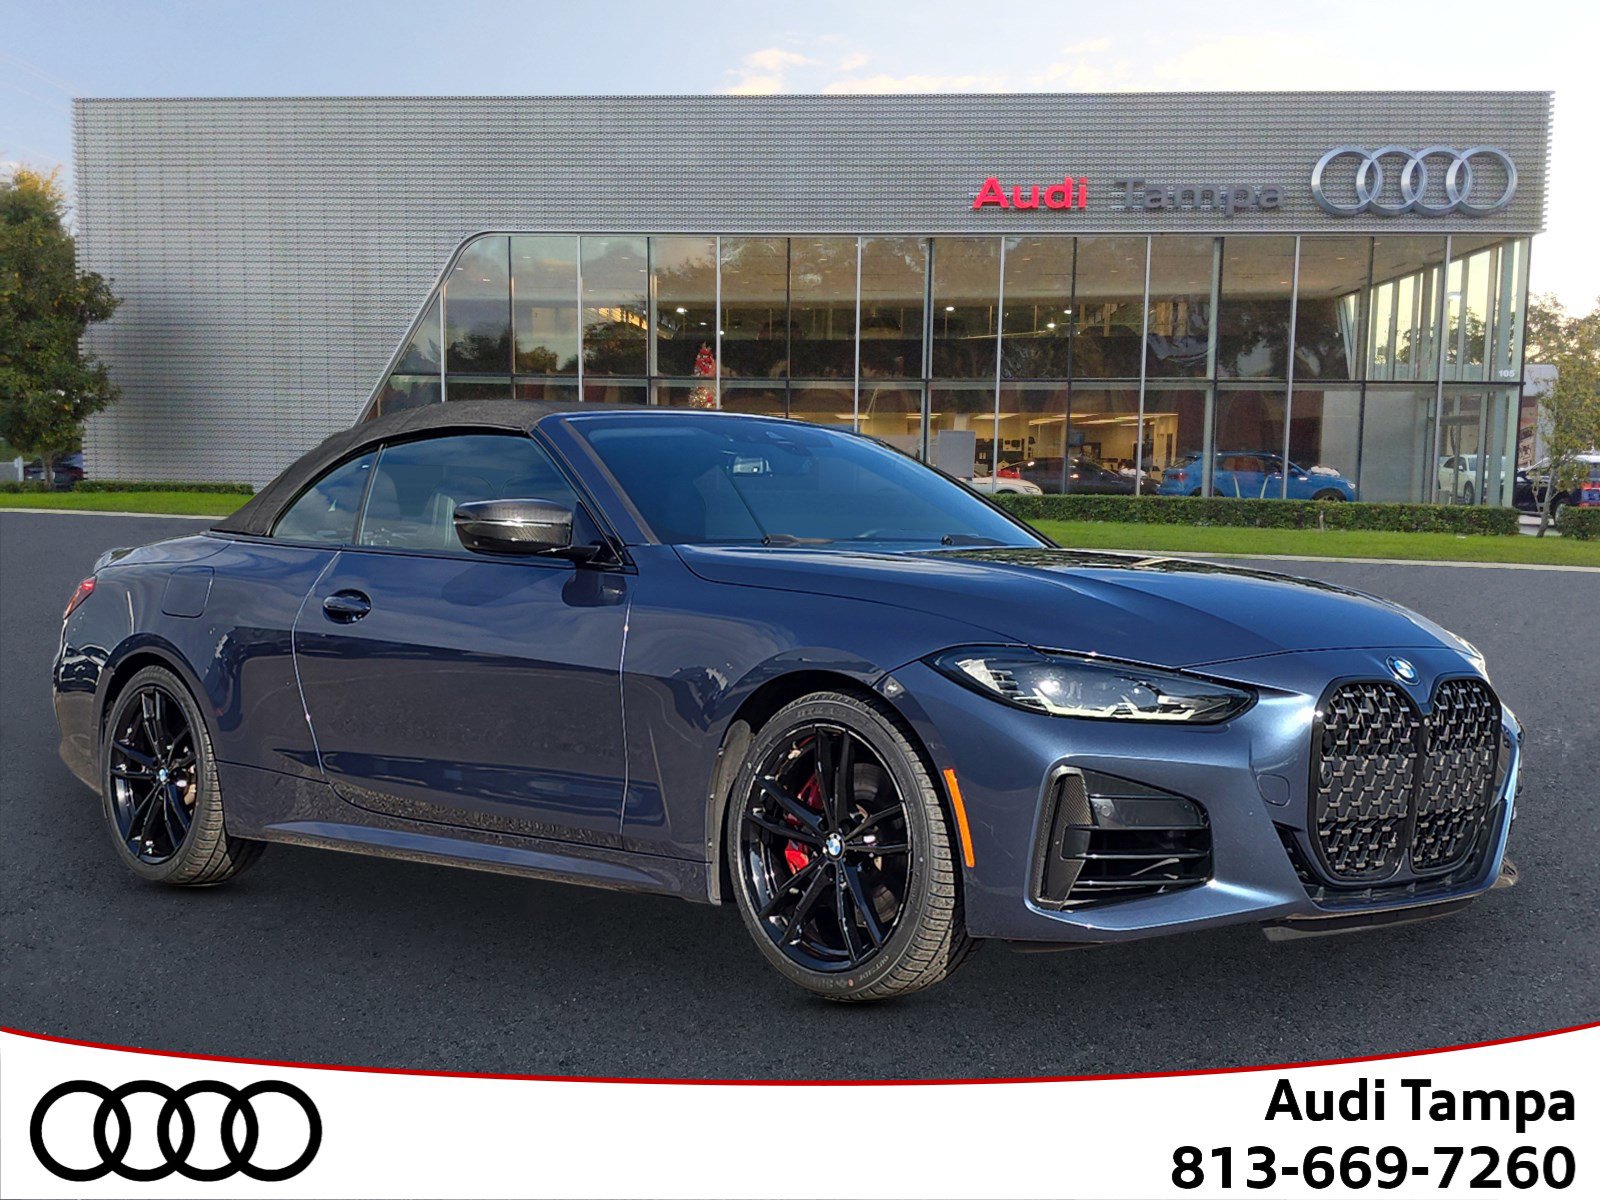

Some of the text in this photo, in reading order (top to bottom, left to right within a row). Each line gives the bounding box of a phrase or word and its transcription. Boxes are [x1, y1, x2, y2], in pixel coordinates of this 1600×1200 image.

[973, 177, 1284, 218] Audi Tampa
[1499, 369, 1516, 378] 105
